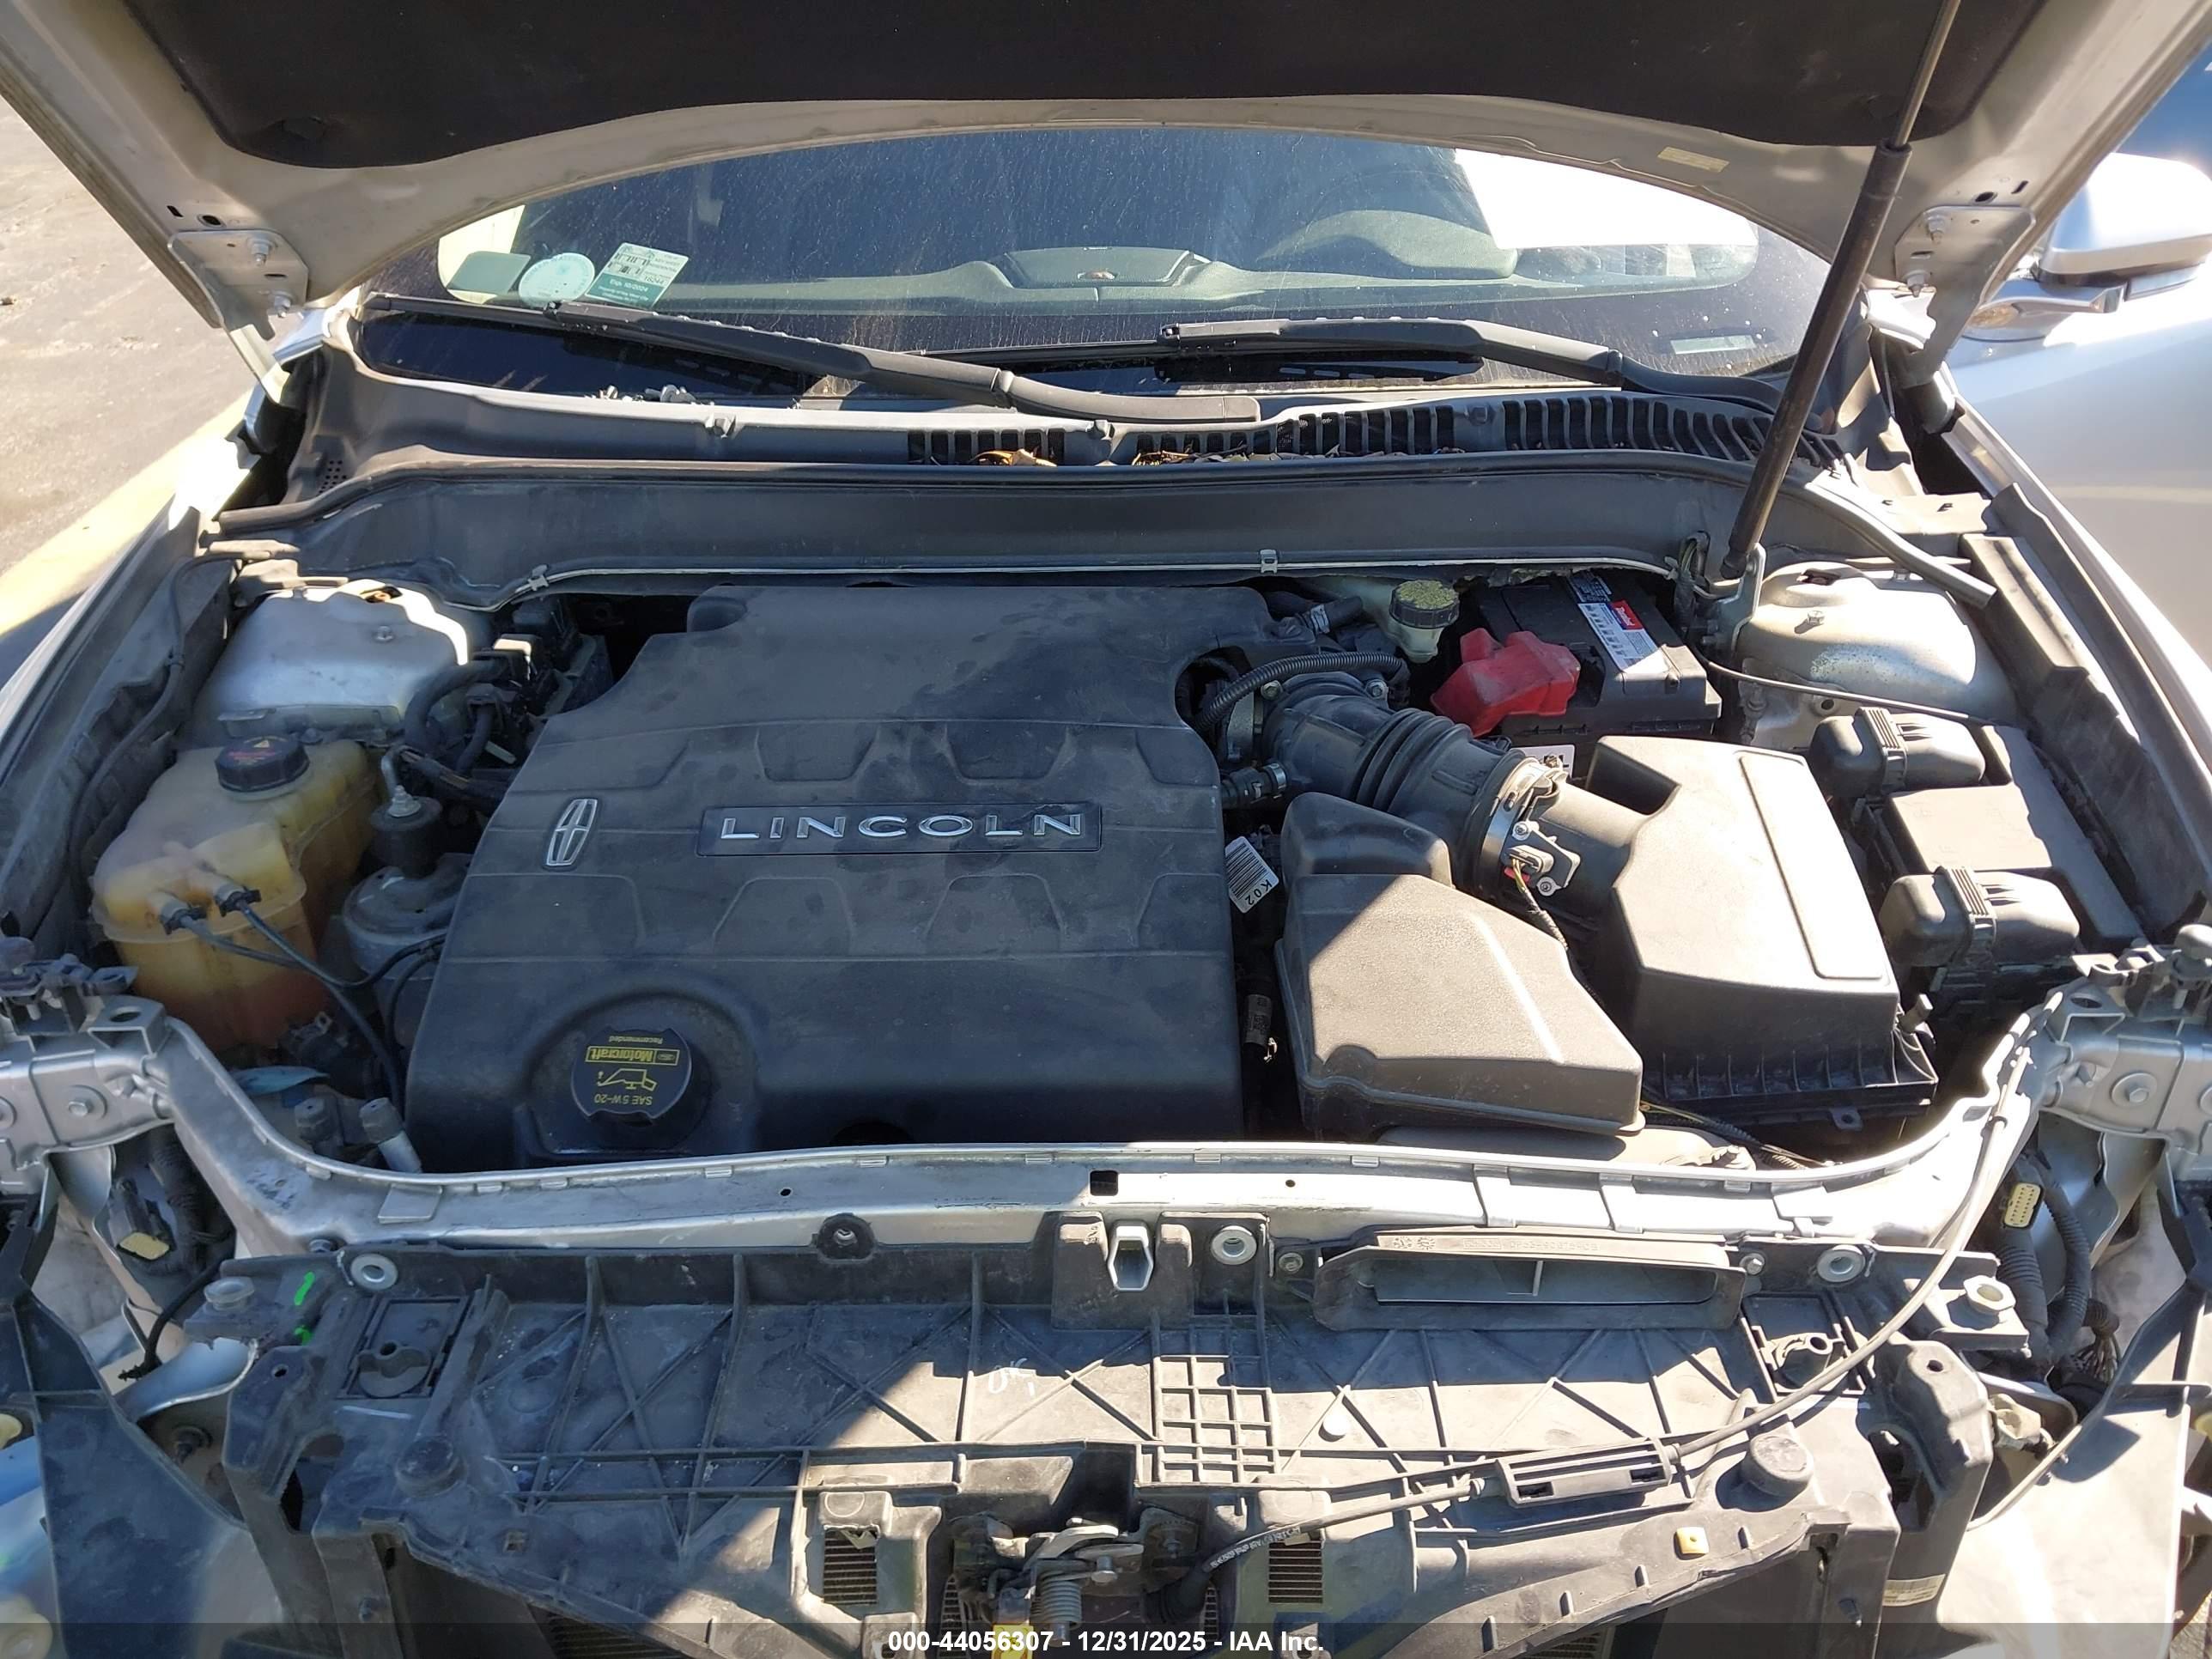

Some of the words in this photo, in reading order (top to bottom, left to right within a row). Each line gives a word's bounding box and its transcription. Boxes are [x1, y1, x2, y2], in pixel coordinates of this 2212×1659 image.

[720, 812, 1082, 840] LINCOLN
[1245, 878, 1273, 906] K02
[608, 1035, 664, 1045] Recommended
[591, 1048, 653, 1062] Motorcraft
[593, 1093, 629, 1104] 5W-20
[631, 1095, 653, 1106] SAE
